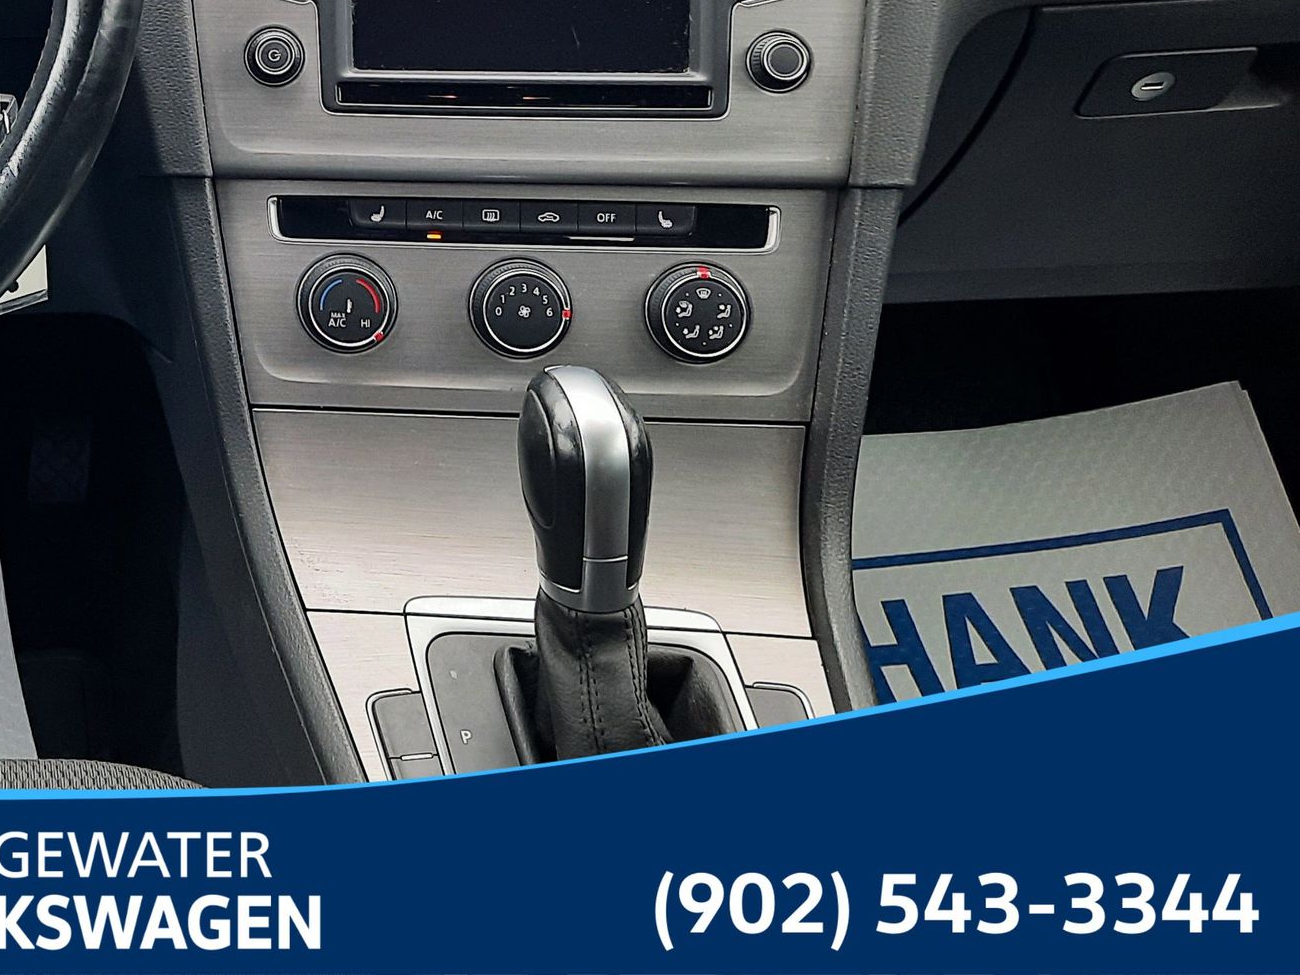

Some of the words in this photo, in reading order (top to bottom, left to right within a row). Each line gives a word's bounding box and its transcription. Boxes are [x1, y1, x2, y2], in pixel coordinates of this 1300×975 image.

[425, 209, 443, 221] A/C
[596, 212, 617, 224] OFF
[508, 286, 516, 296] 2
[521, 283, 528, 293] 3
[532, 286, 541, 297] 4
[500, 294, 506, 304] 1
[542, 294, 549, 305] 5
[330, 311, 347, 320] MAX
[494, 307, 503, 317] 0
[546, 307, 554, 317] 6
[328, 318, 347, 329] A/C
[360, 319, 371, 329] HI
[460, 729, 475, 745] P
